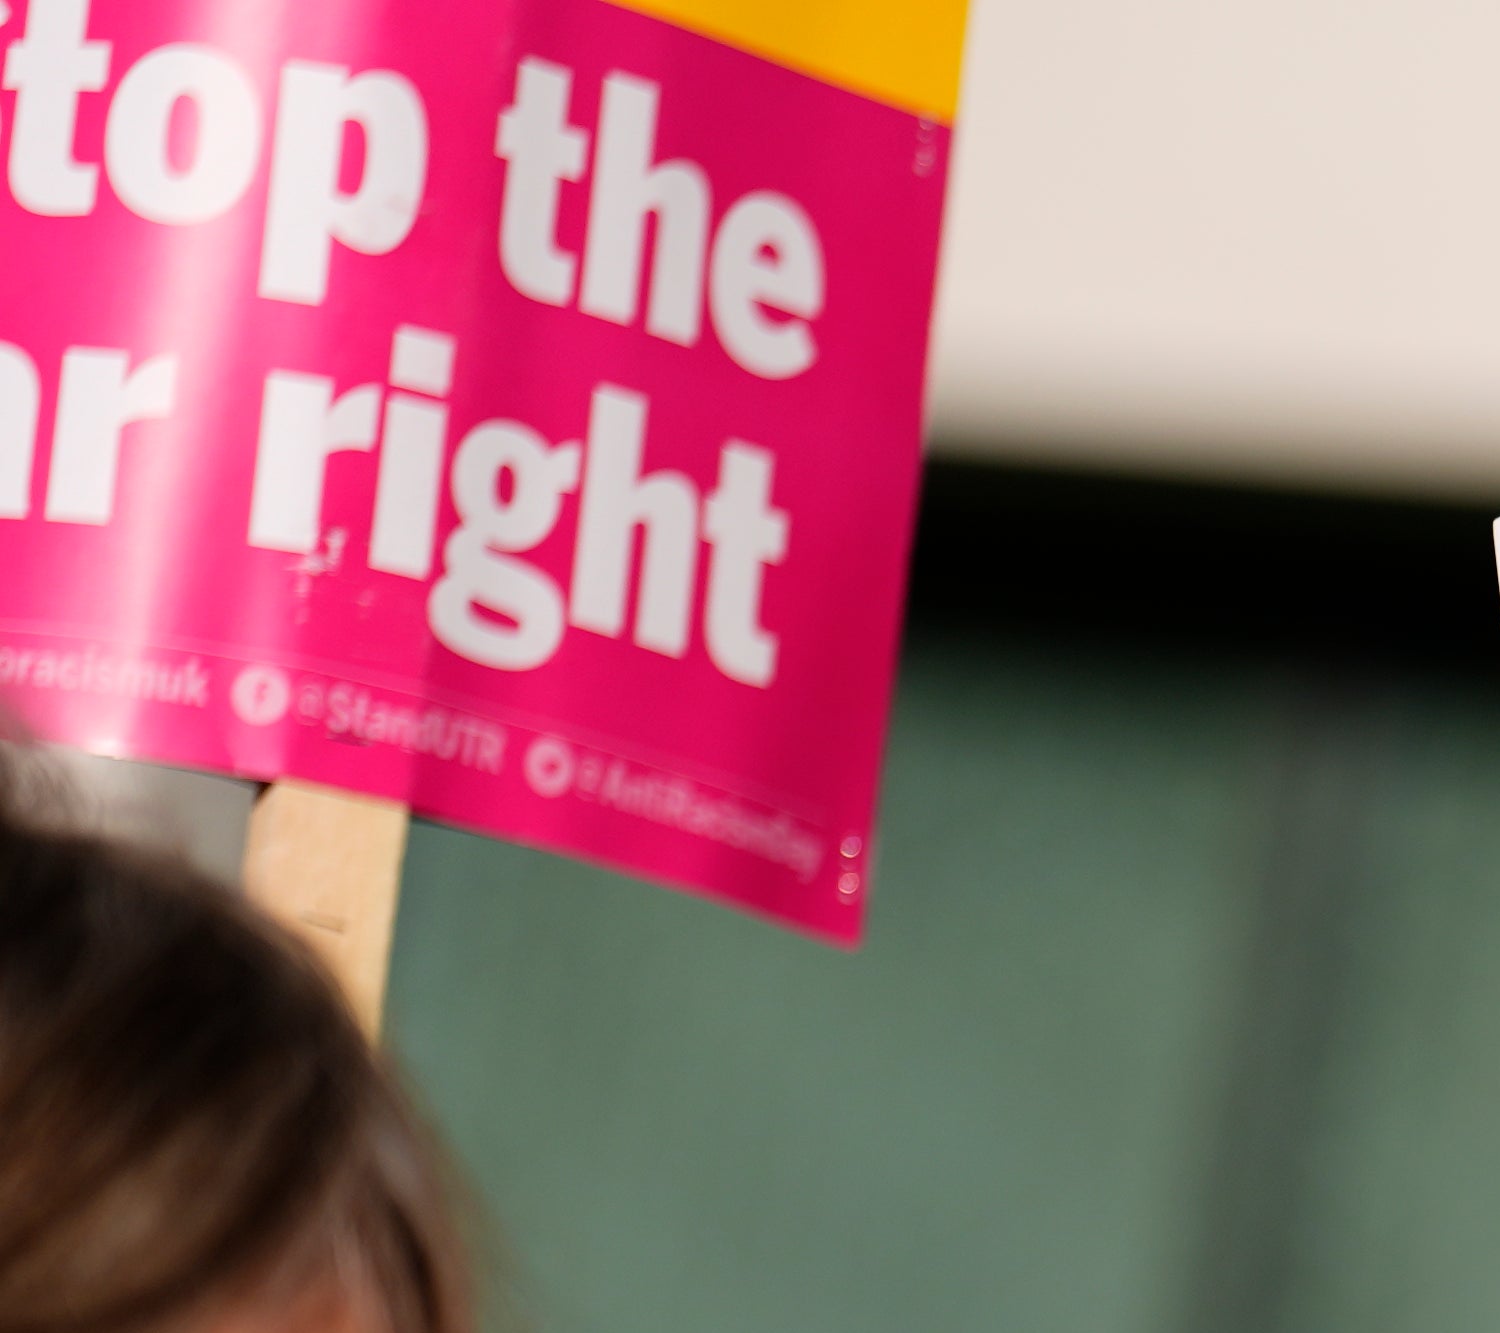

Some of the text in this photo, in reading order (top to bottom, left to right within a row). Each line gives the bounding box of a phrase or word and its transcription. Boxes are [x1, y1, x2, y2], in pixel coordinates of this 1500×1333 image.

[0, 0, 826, 381] top the
[246, 324, 790, 690] right
